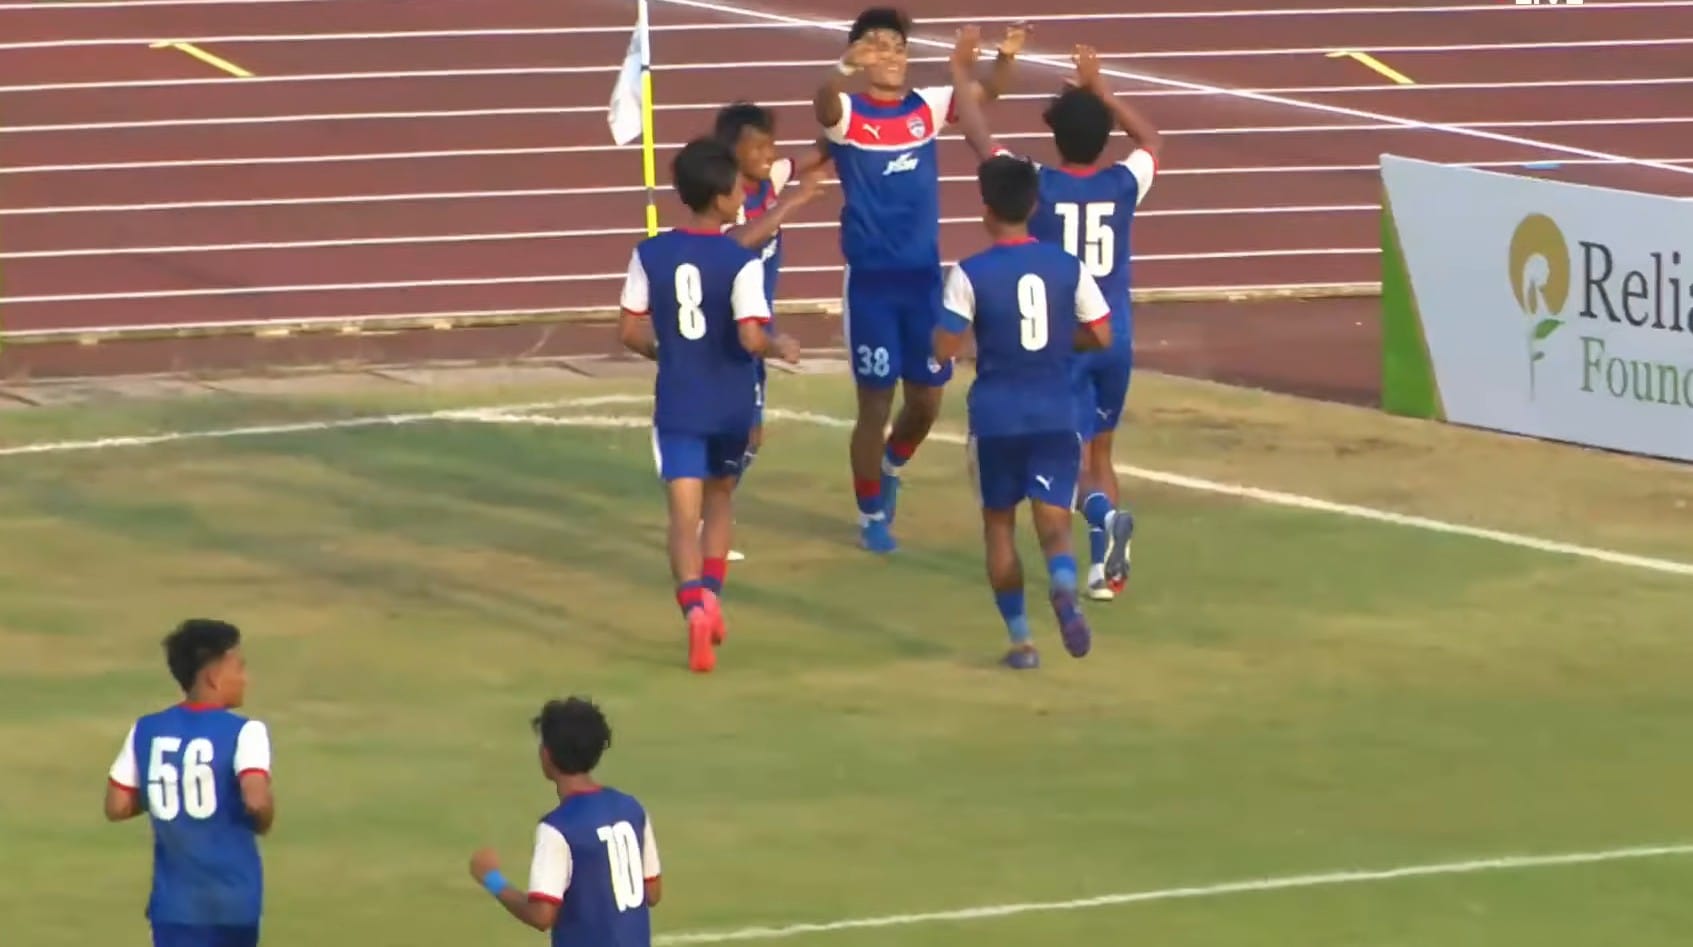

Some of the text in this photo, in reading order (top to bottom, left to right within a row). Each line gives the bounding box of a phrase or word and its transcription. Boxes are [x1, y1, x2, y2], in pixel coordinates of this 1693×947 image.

[1055, 202, 1116, 277] 15
[674, 262, 707, 341] 8
[1017, 273, 1050, 351] 9
[1578, 240, 1693, 334] Reli
[857, 344, 890, 377] 38
[147, 737, 217, 821] 56
[597, 820, 646, 913] 10
